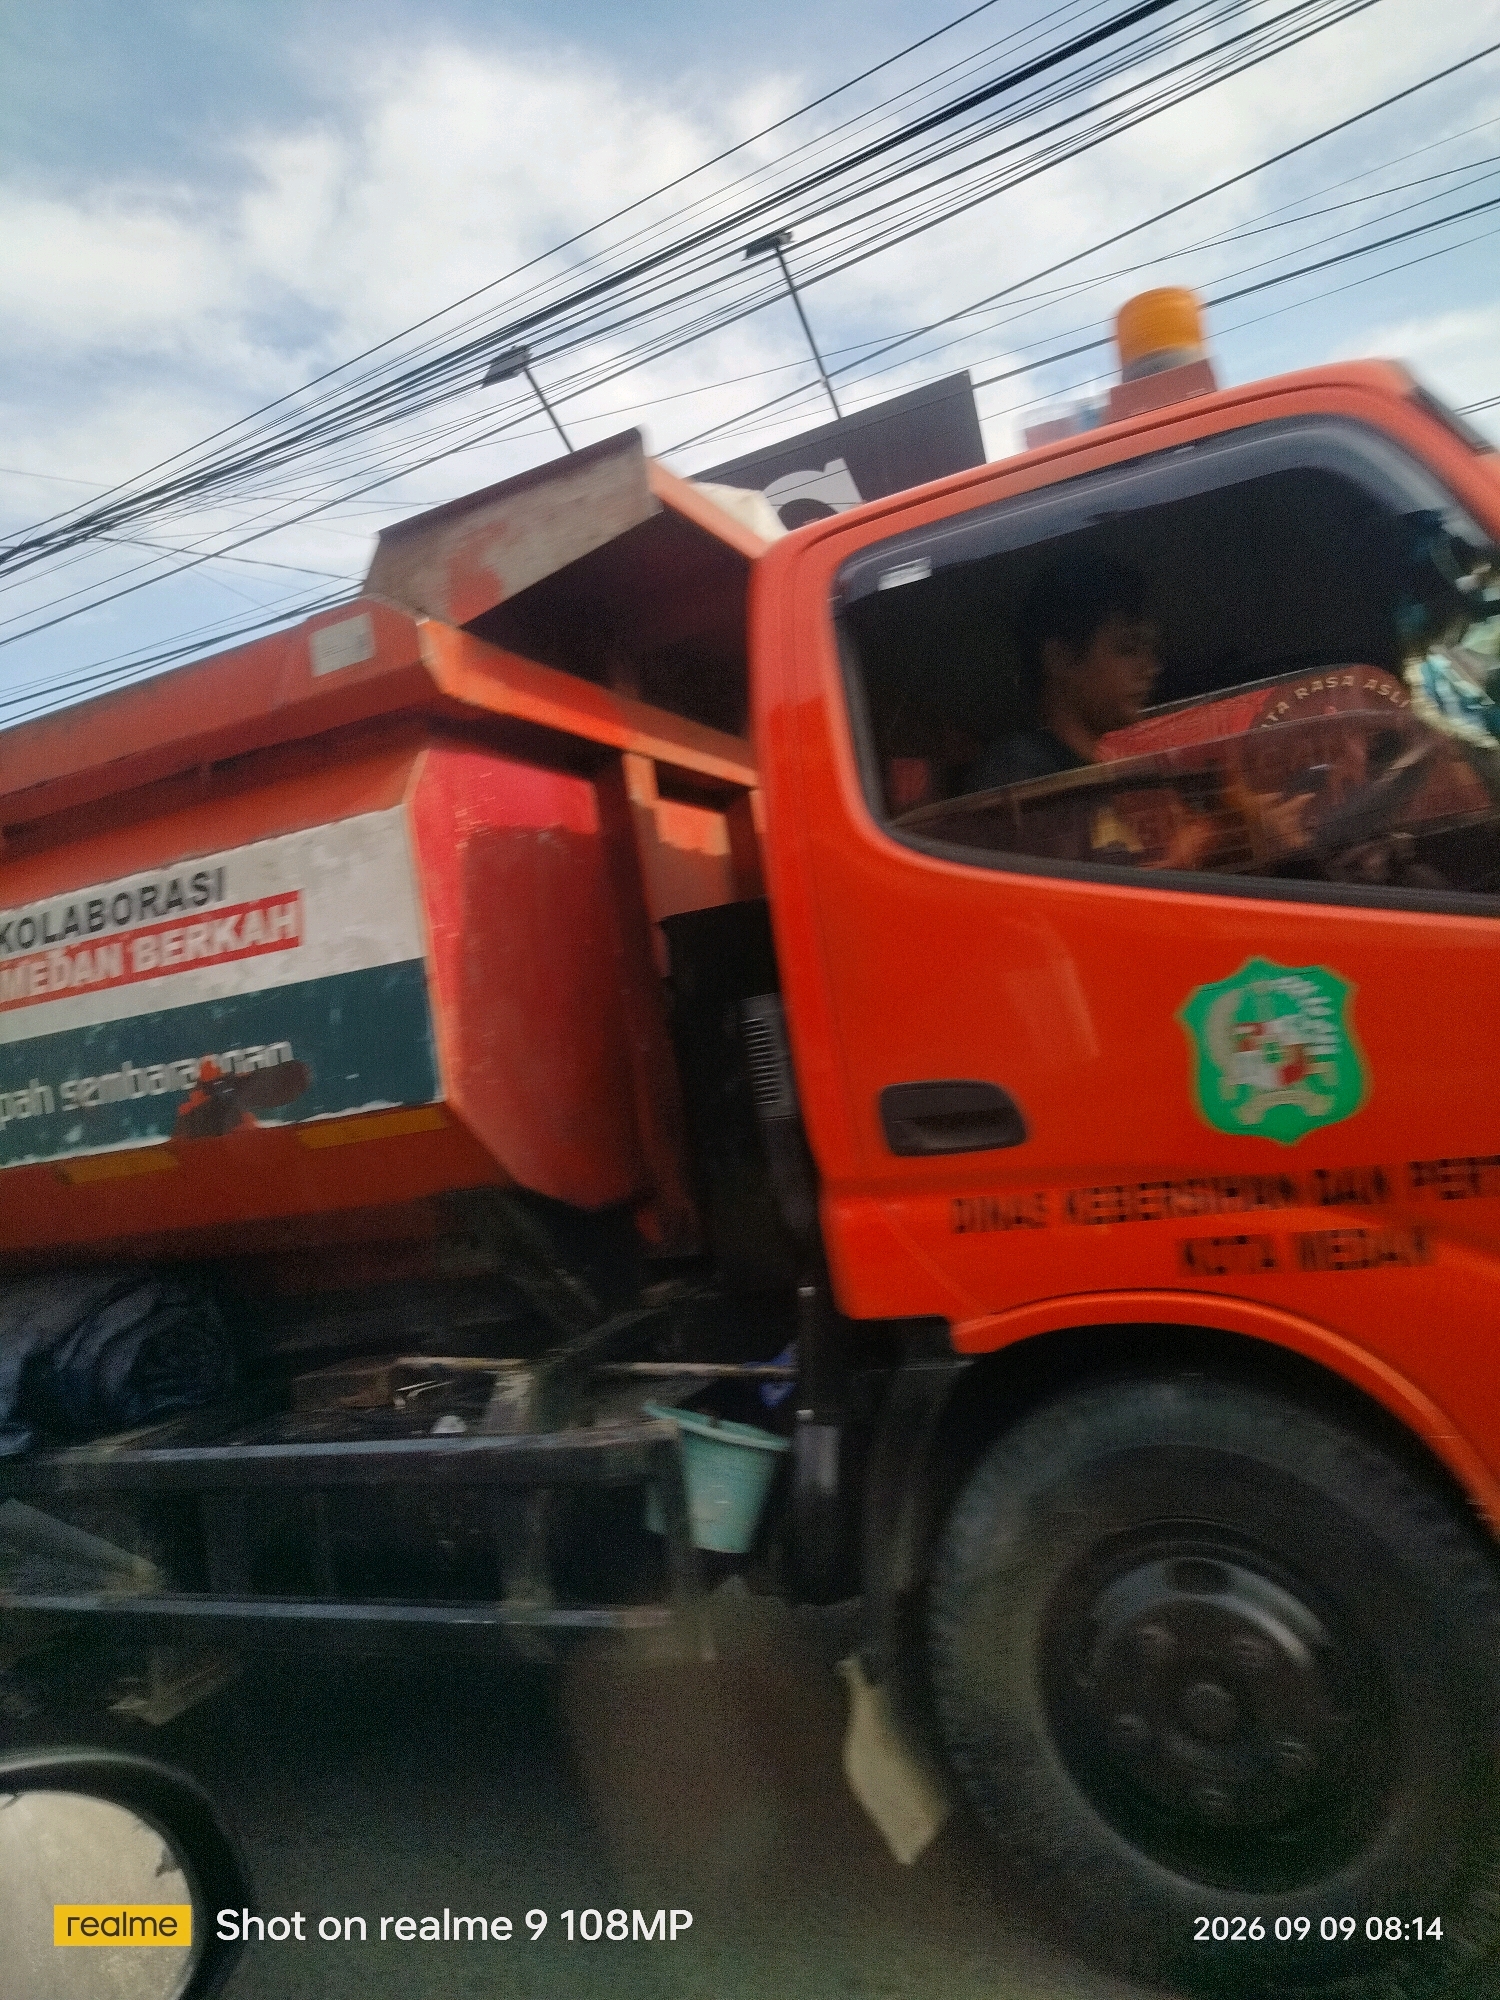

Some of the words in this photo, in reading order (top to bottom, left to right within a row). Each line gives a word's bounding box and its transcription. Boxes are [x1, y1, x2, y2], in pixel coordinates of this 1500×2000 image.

[1294, 675, 1354, 700] RASA
[1363, 678, 1411, 708] ASLI
[0, 866, 227, 954] KOLABORASI
[131, 901, 298, 974] BERKAH
